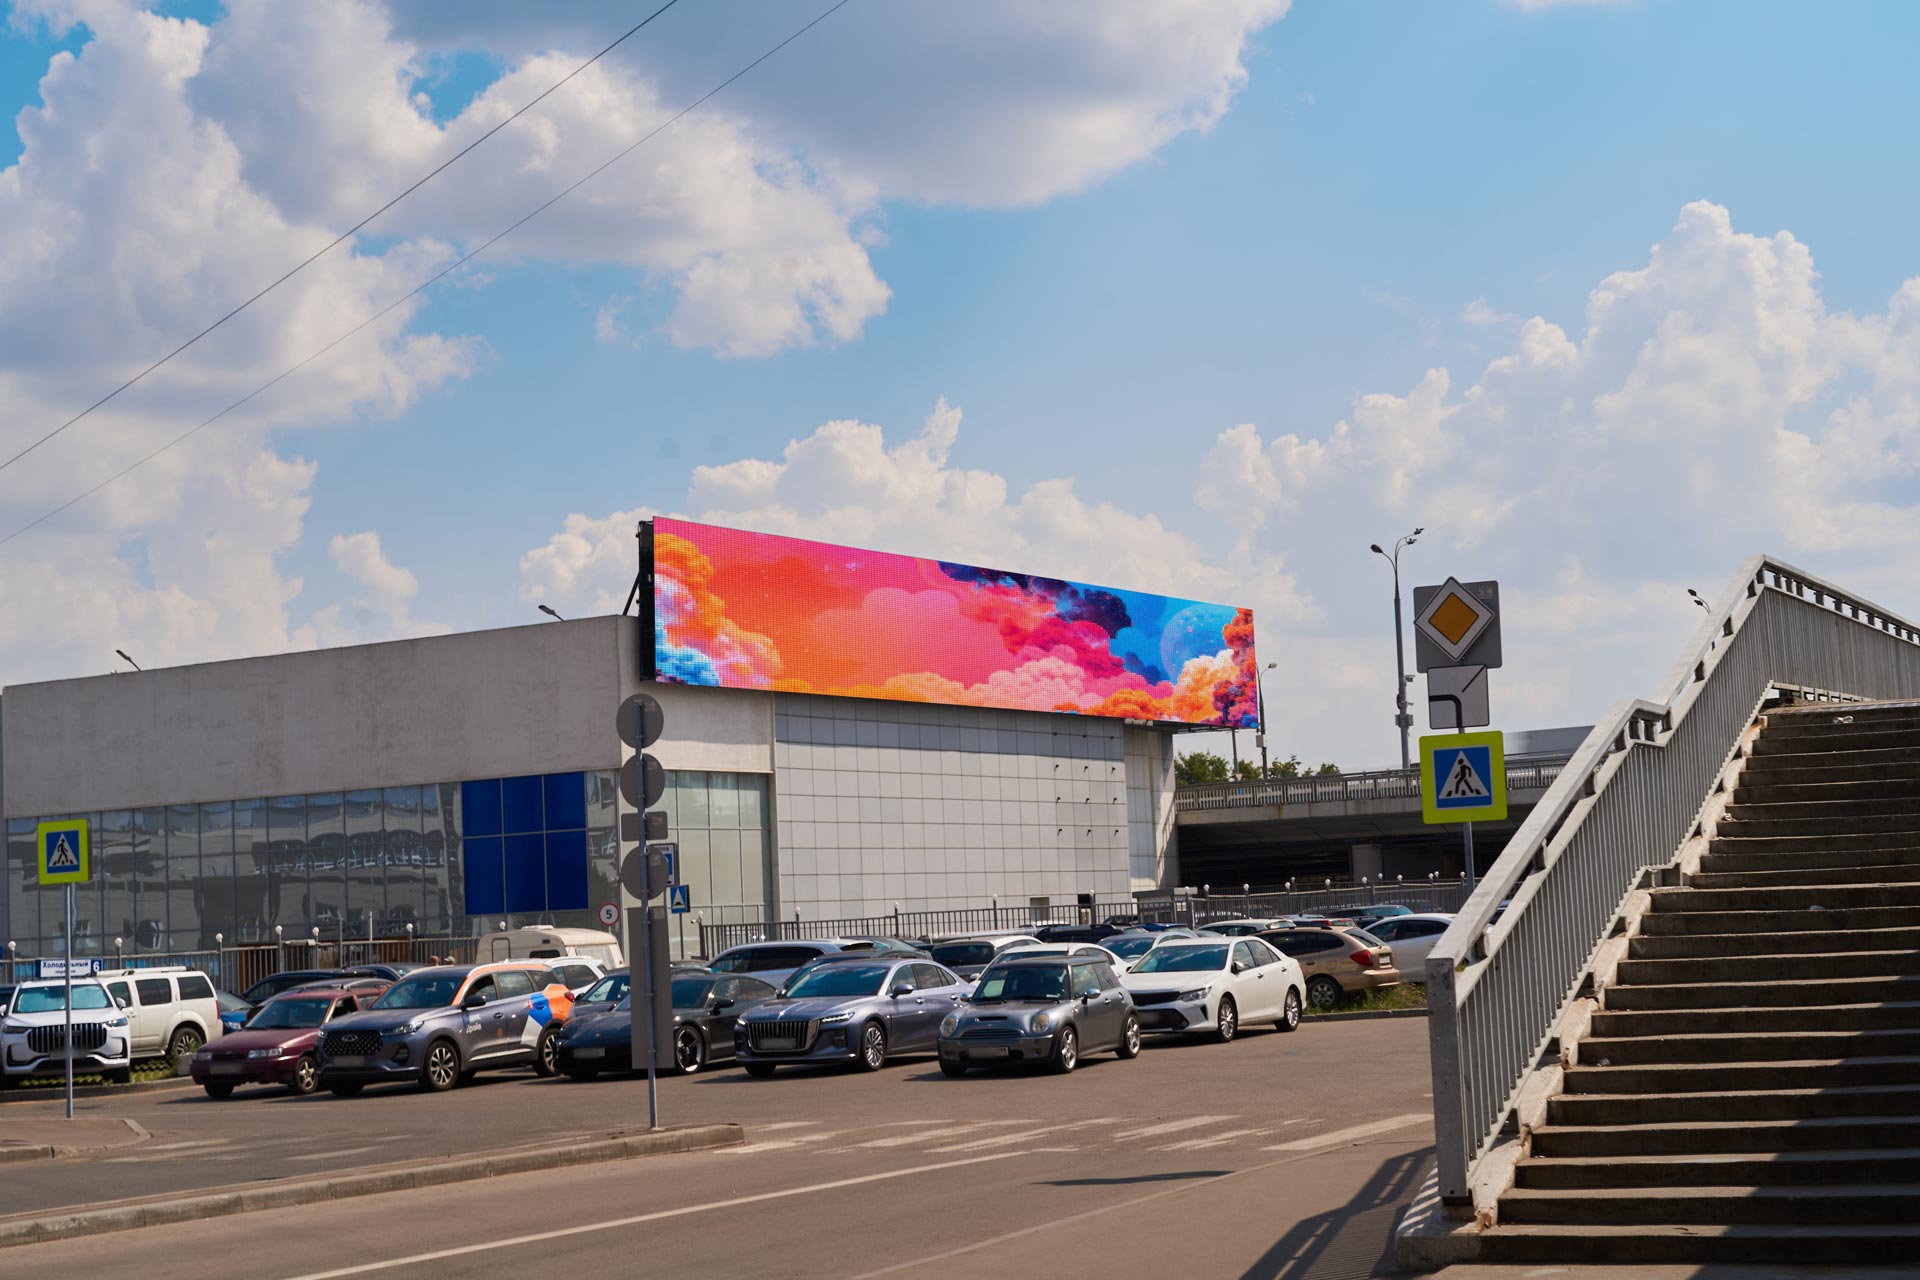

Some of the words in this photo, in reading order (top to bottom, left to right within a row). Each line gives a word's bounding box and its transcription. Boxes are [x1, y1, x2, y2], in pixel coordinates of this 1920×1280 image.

[606, 909, 613, 919] 5
[43, 960, 88, 968] Холодьный
[93, 961, 100, 972] 6
